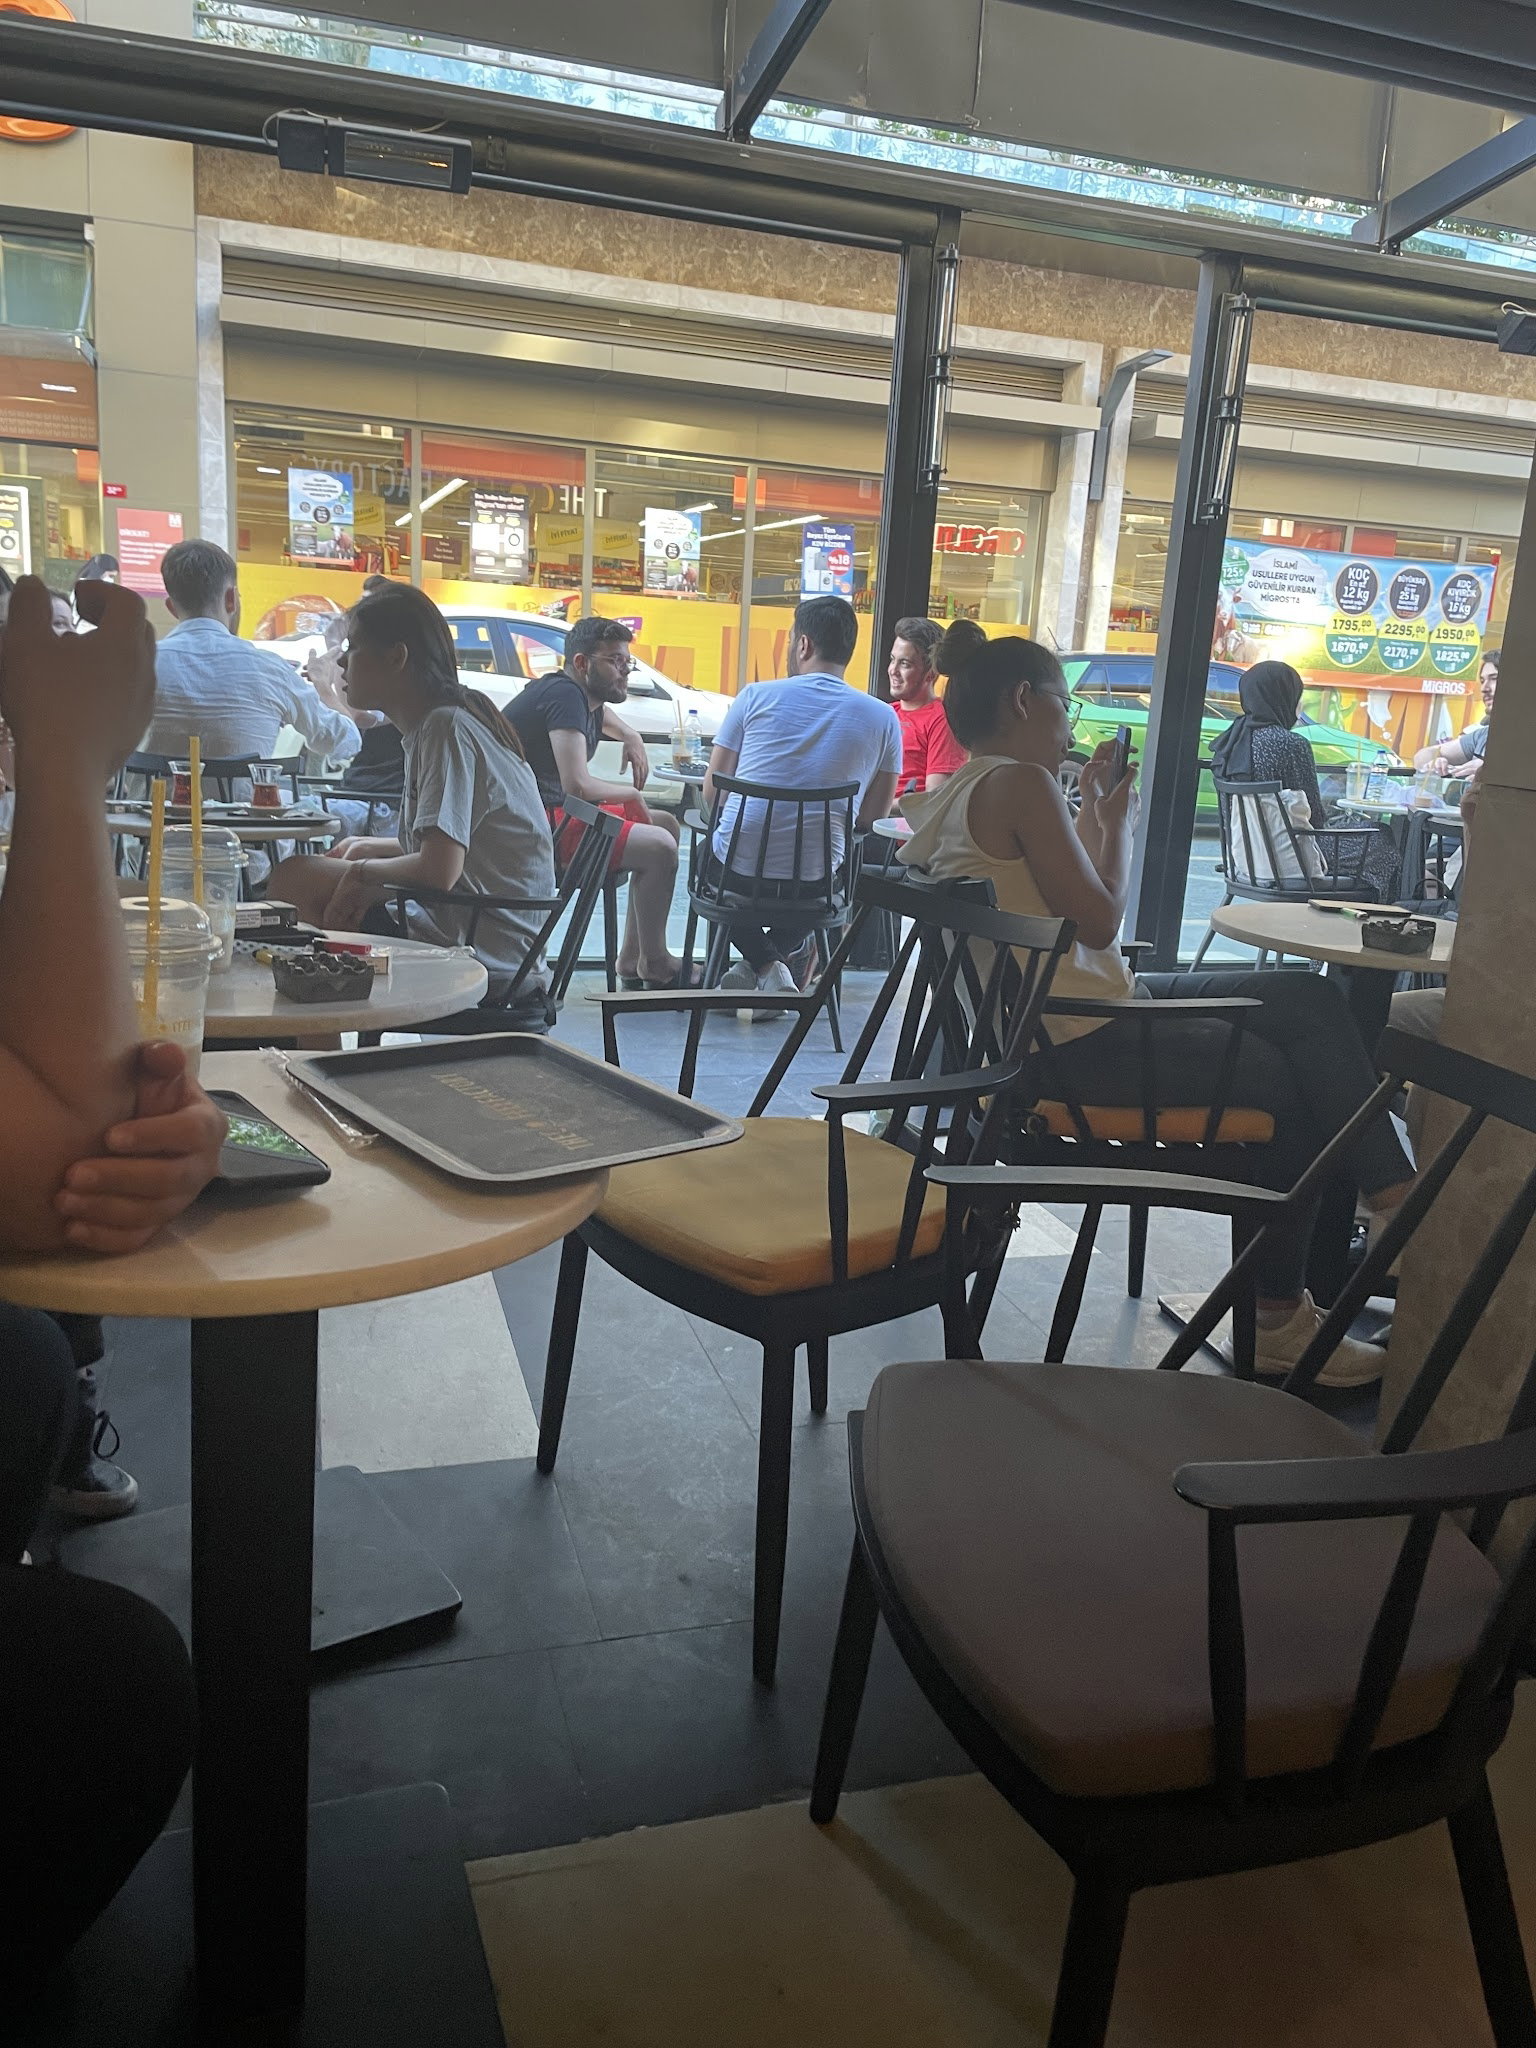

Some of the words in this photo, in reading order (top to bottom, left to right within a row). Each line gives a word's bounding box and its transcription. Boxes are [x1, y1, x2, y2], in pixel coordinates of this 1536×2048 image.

[828, 554, 850, 566] %18
[1273, 558, 1299, 571] İSLAMİ
[1252, 569, 1288, 581] USULLERE
[1289, 573, 1315, 583] UYGUN
[1347, 567, 1371, 582] KOÇ
[1247, 579, 1286, 593] GÜVENİLİR
[1287, 583, 1317, 595] KURBAN
[1342, 586, 1356, 599] 12
[1357, 588, 1370, 602] kg
[1399, 590, 1410, 601] 25
